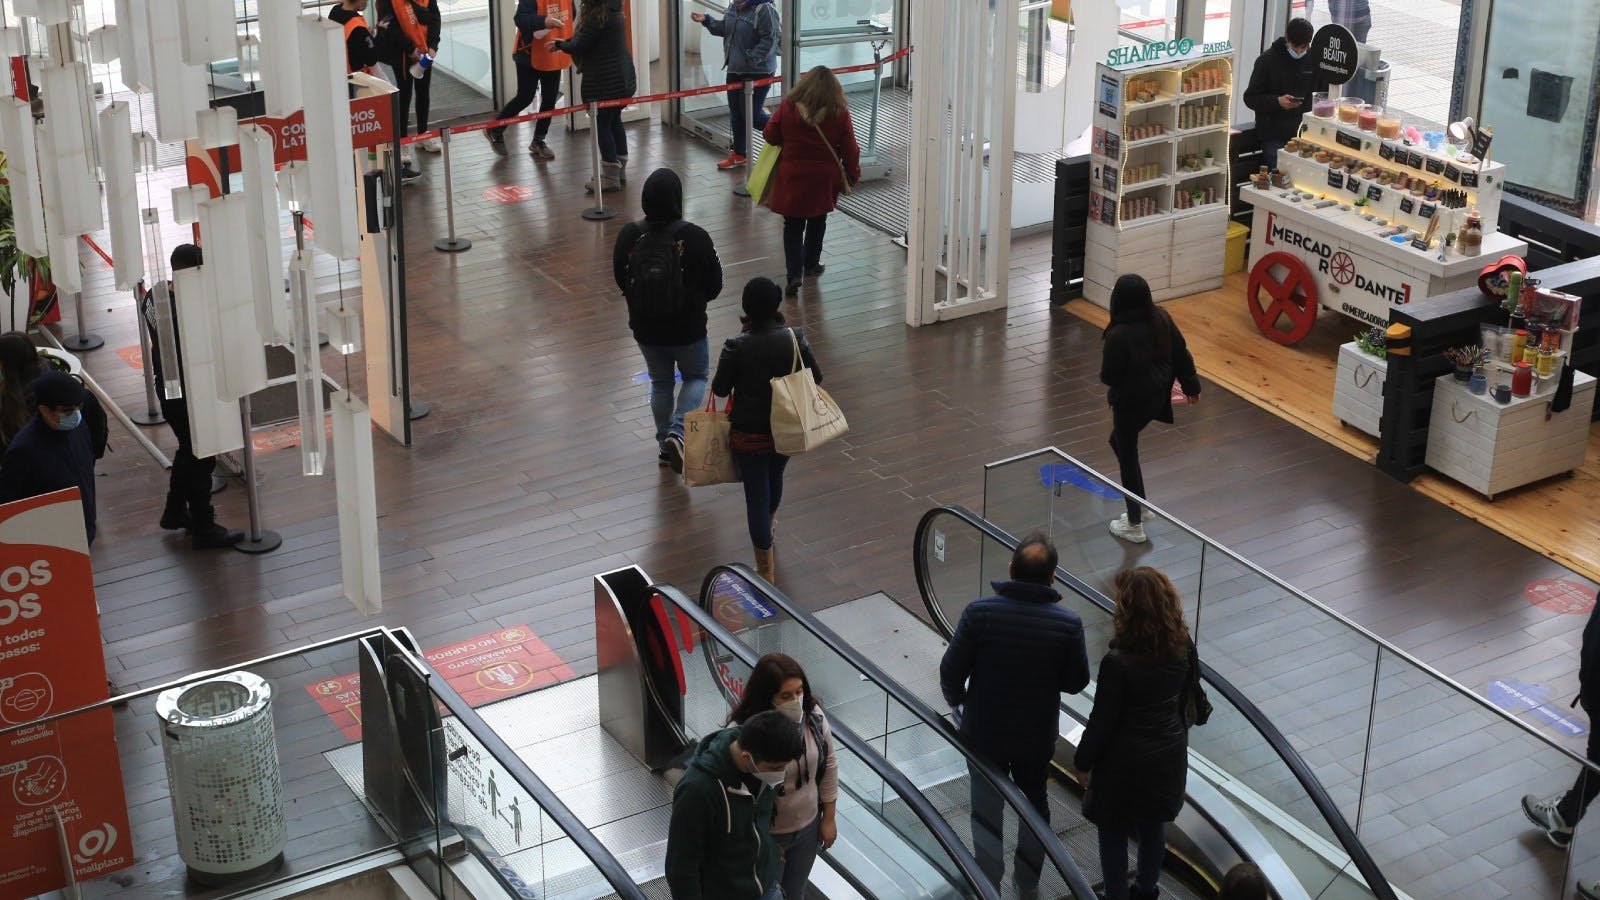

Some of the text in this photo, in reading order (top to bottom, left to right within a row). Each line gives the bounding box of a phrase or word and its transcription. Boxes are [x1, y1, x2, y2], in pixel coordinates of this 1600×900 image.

[1106, 37, 1233, 66] SHAMPOO BARRA
[1329, 36, 1341, 50] BIO
[1323, 47, 1347, 64] BEAUTY
[690, 420, 699, 433] R
[5, 628, 45, 645] todos
[478, 638, 497, 648] NO
[427, 644, 477, 662] CARROS
[447, 644, 523, 670] ATRAPAMIENTO
[75, 857, 125, 877] mallplaza
